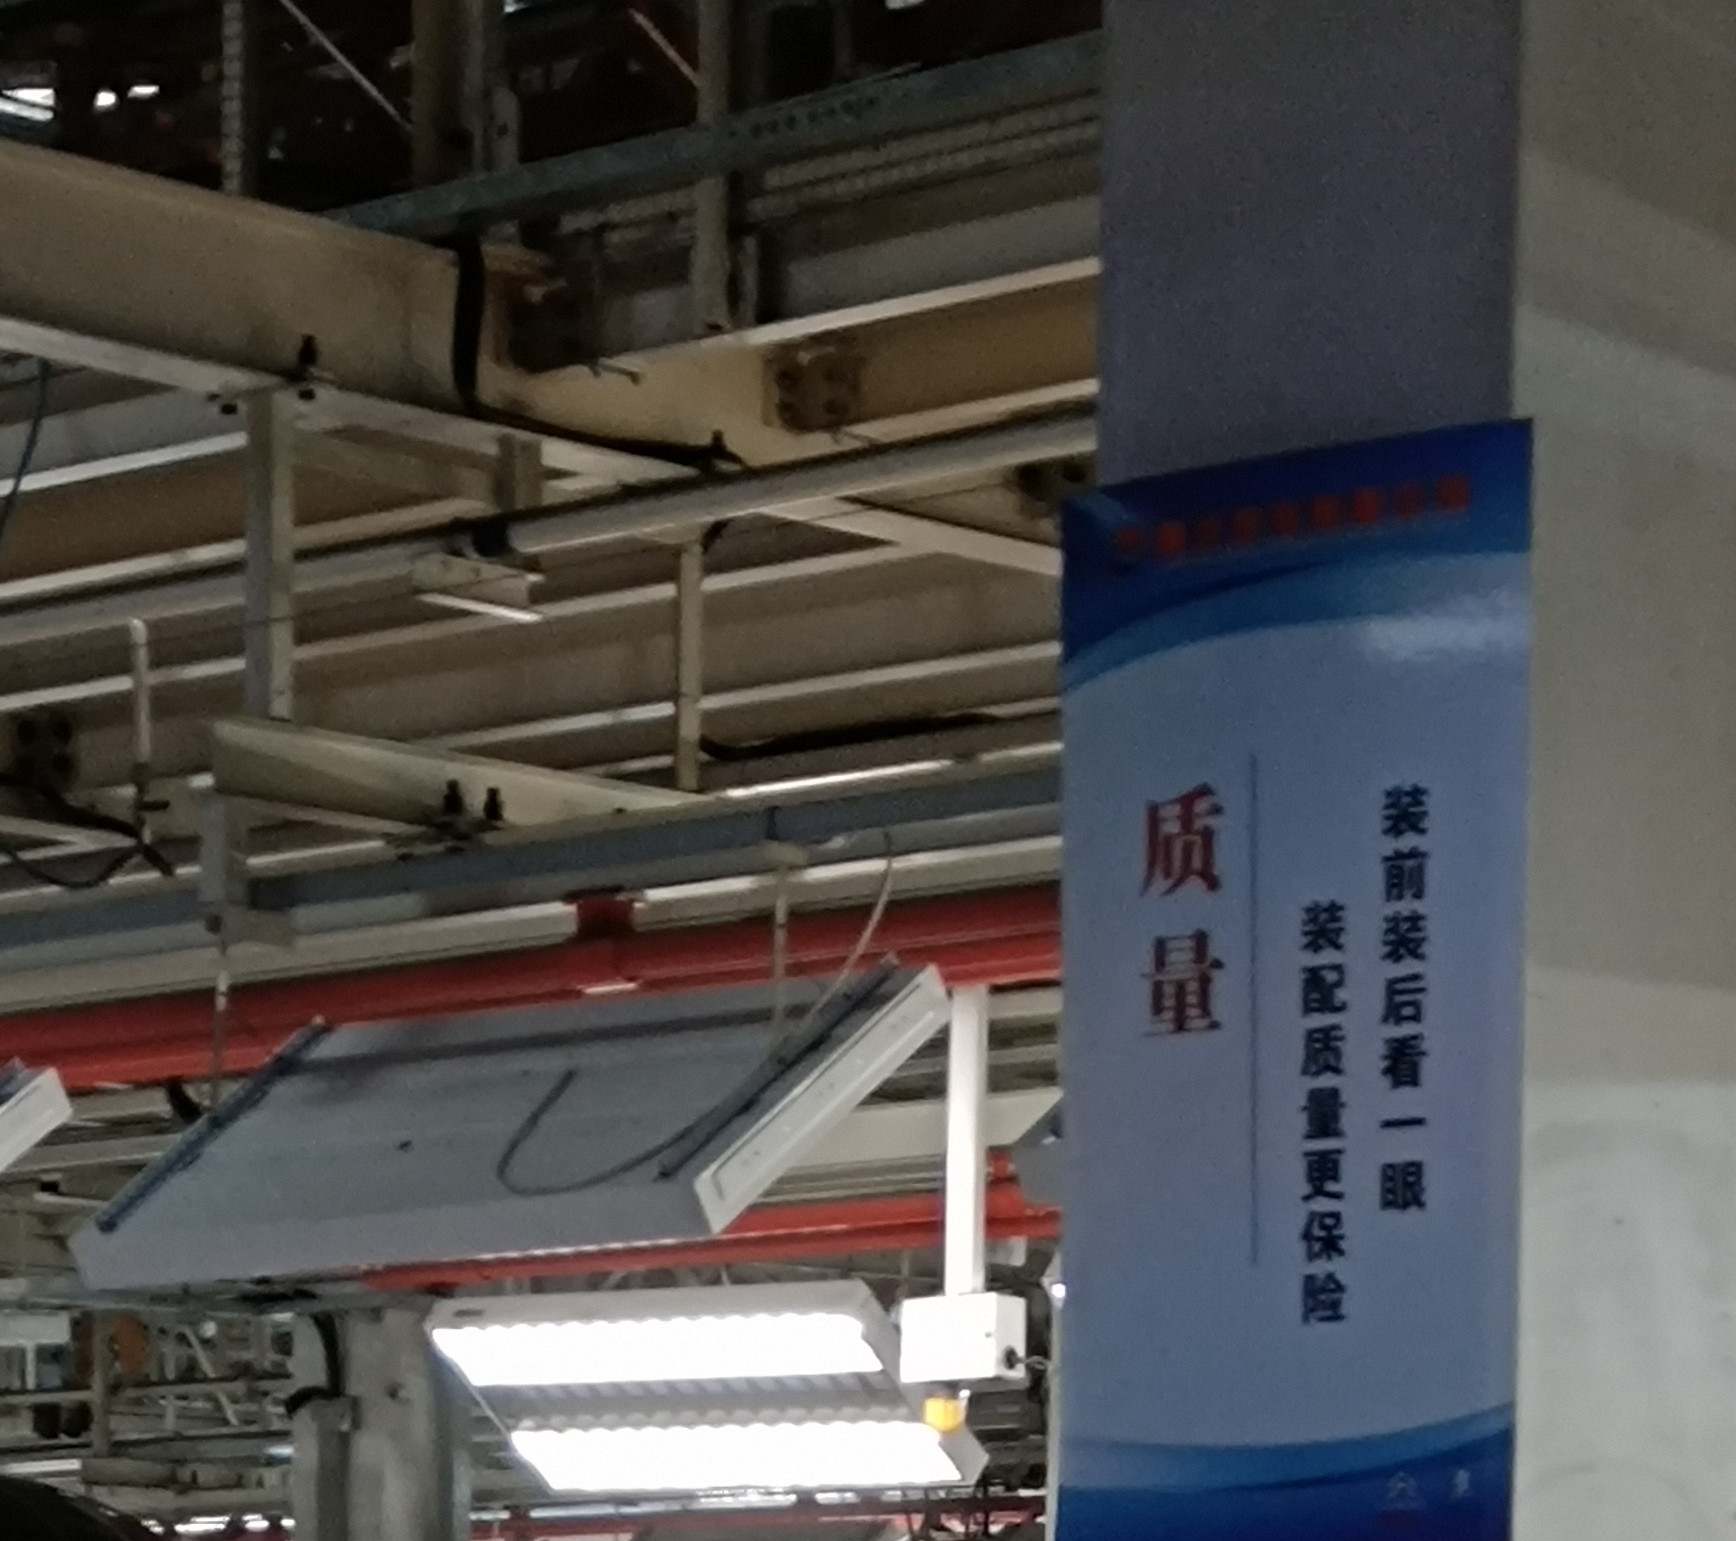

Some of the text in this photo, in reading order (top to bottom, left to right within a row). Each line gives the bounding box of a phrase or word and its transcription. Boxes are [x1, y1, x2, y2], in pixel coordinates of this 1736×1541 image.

[1140, 783, 1224, 1037] 质量
[1300, 899, 1348, 1325] 装配质量更保险
[1381, 783, 1430, 1211] 装前装后看一眼
